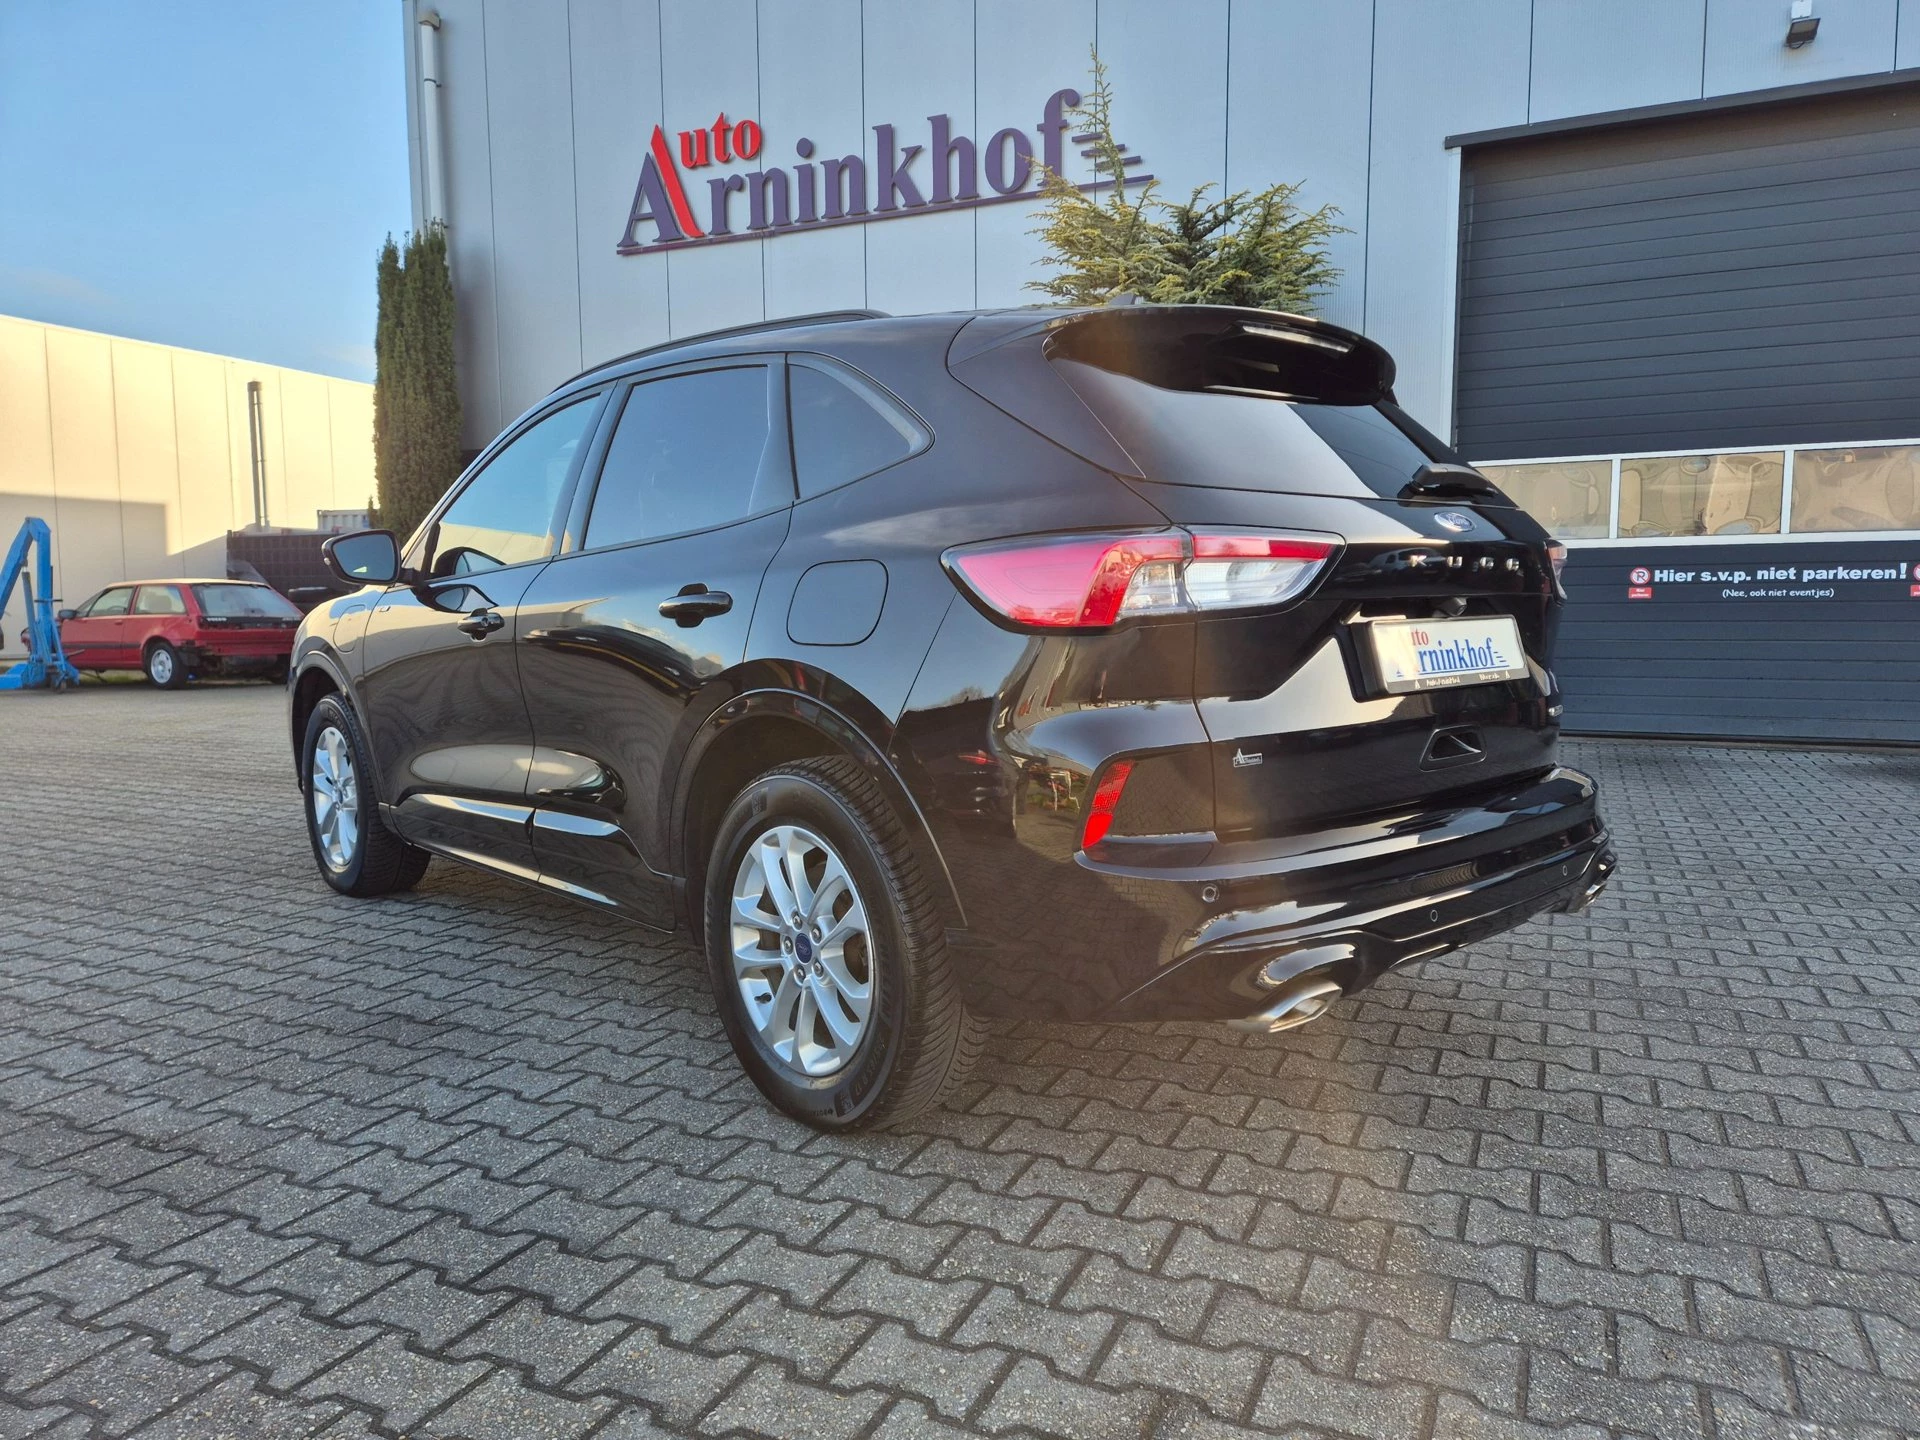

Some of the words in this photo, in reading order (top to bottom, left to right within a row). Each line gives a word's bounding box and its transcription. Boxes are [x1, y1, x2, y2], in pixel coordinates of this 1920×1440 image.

[617, 88, 1081, 247] Arninkhof
[1654, 569, 1695, 582] Hier
[1700, 571, 1751, 583] s.v.p.
[1757, 567, 1796, 580] niet
[1722, 588, 1748, 599] (Nee,
[1749, 588, 1767, 597] ook
[1768, 588, 1788, 597] niet
[1789, 587, 1835, 599] eventjes)
